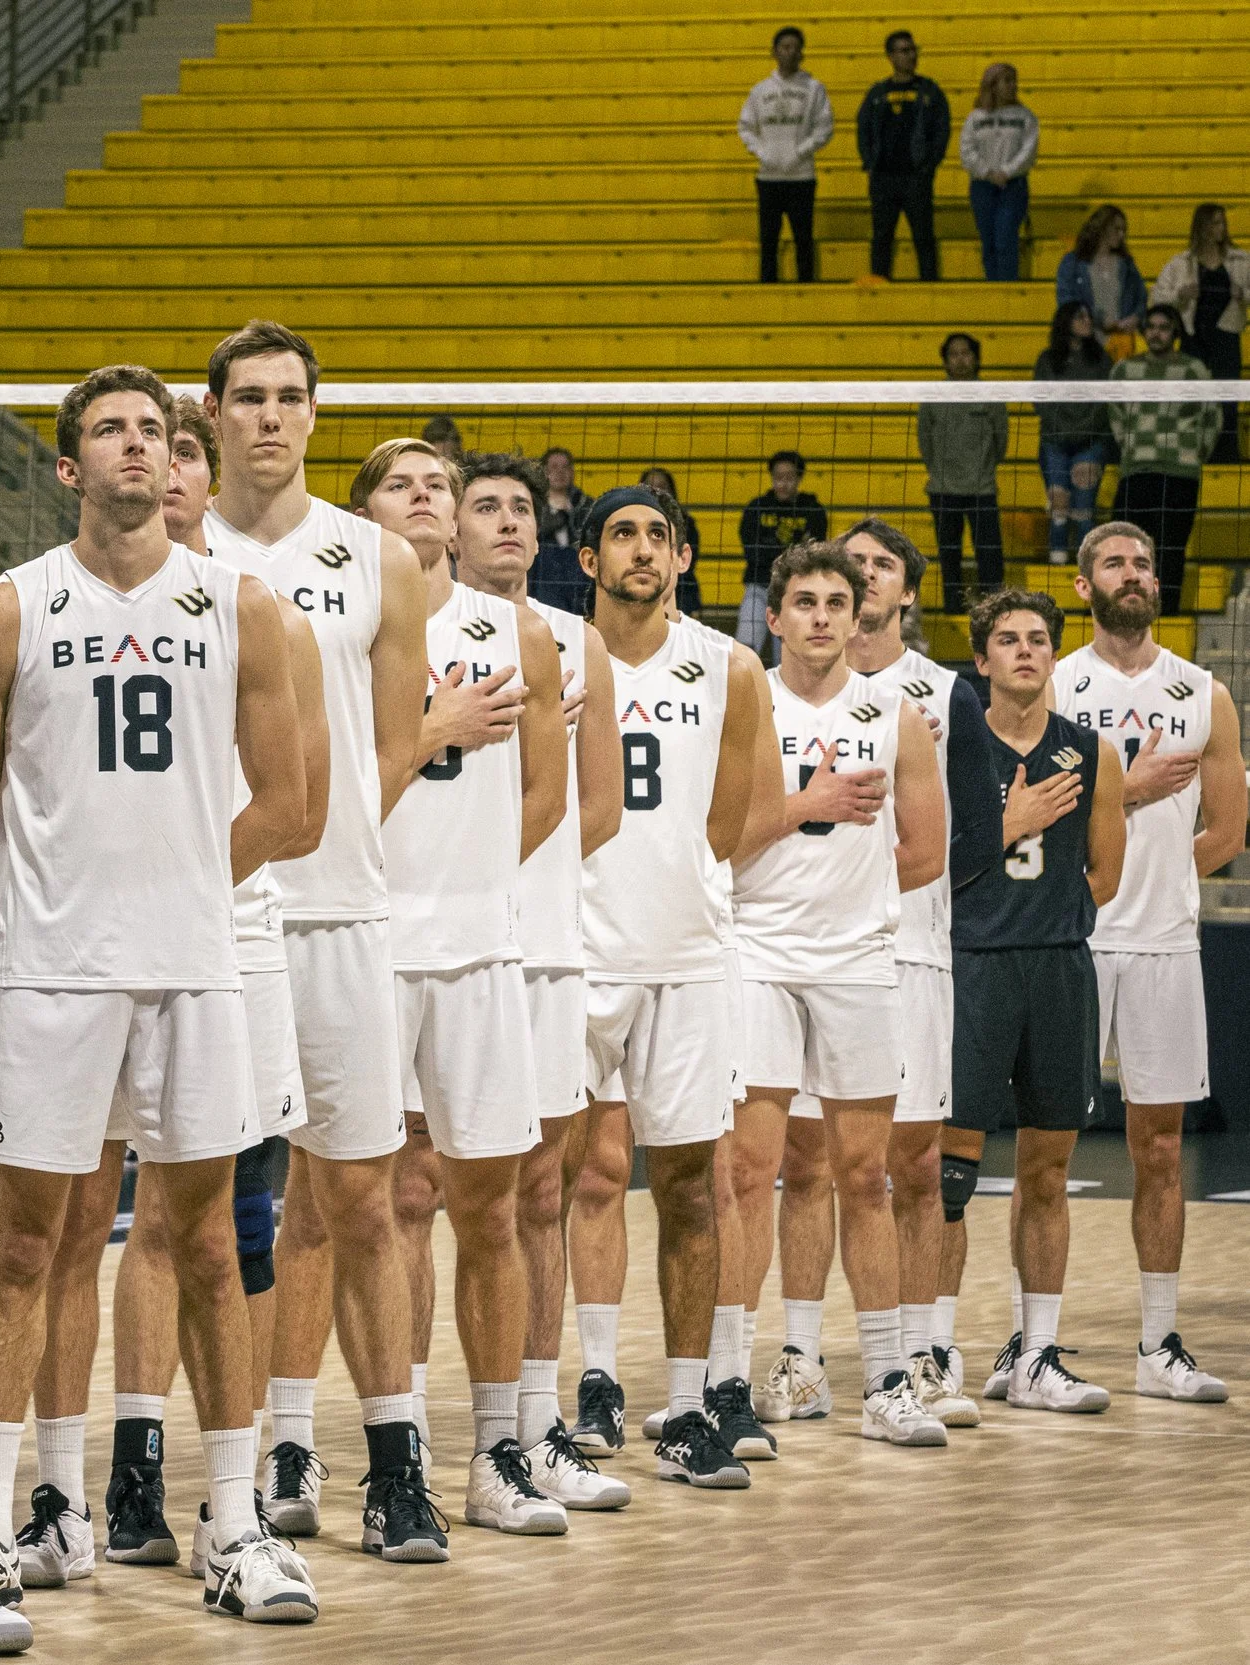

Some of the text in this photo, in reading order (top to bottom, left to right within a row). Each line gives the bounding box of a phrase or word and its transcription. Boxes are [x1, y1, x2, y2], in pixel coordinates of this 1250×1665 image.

[52, 634, 206, 669] BEACH
[93, 674, 174, 772] 18
[620, 700, 700, 726] ACH
[782, 736, 874, 762] EACH
